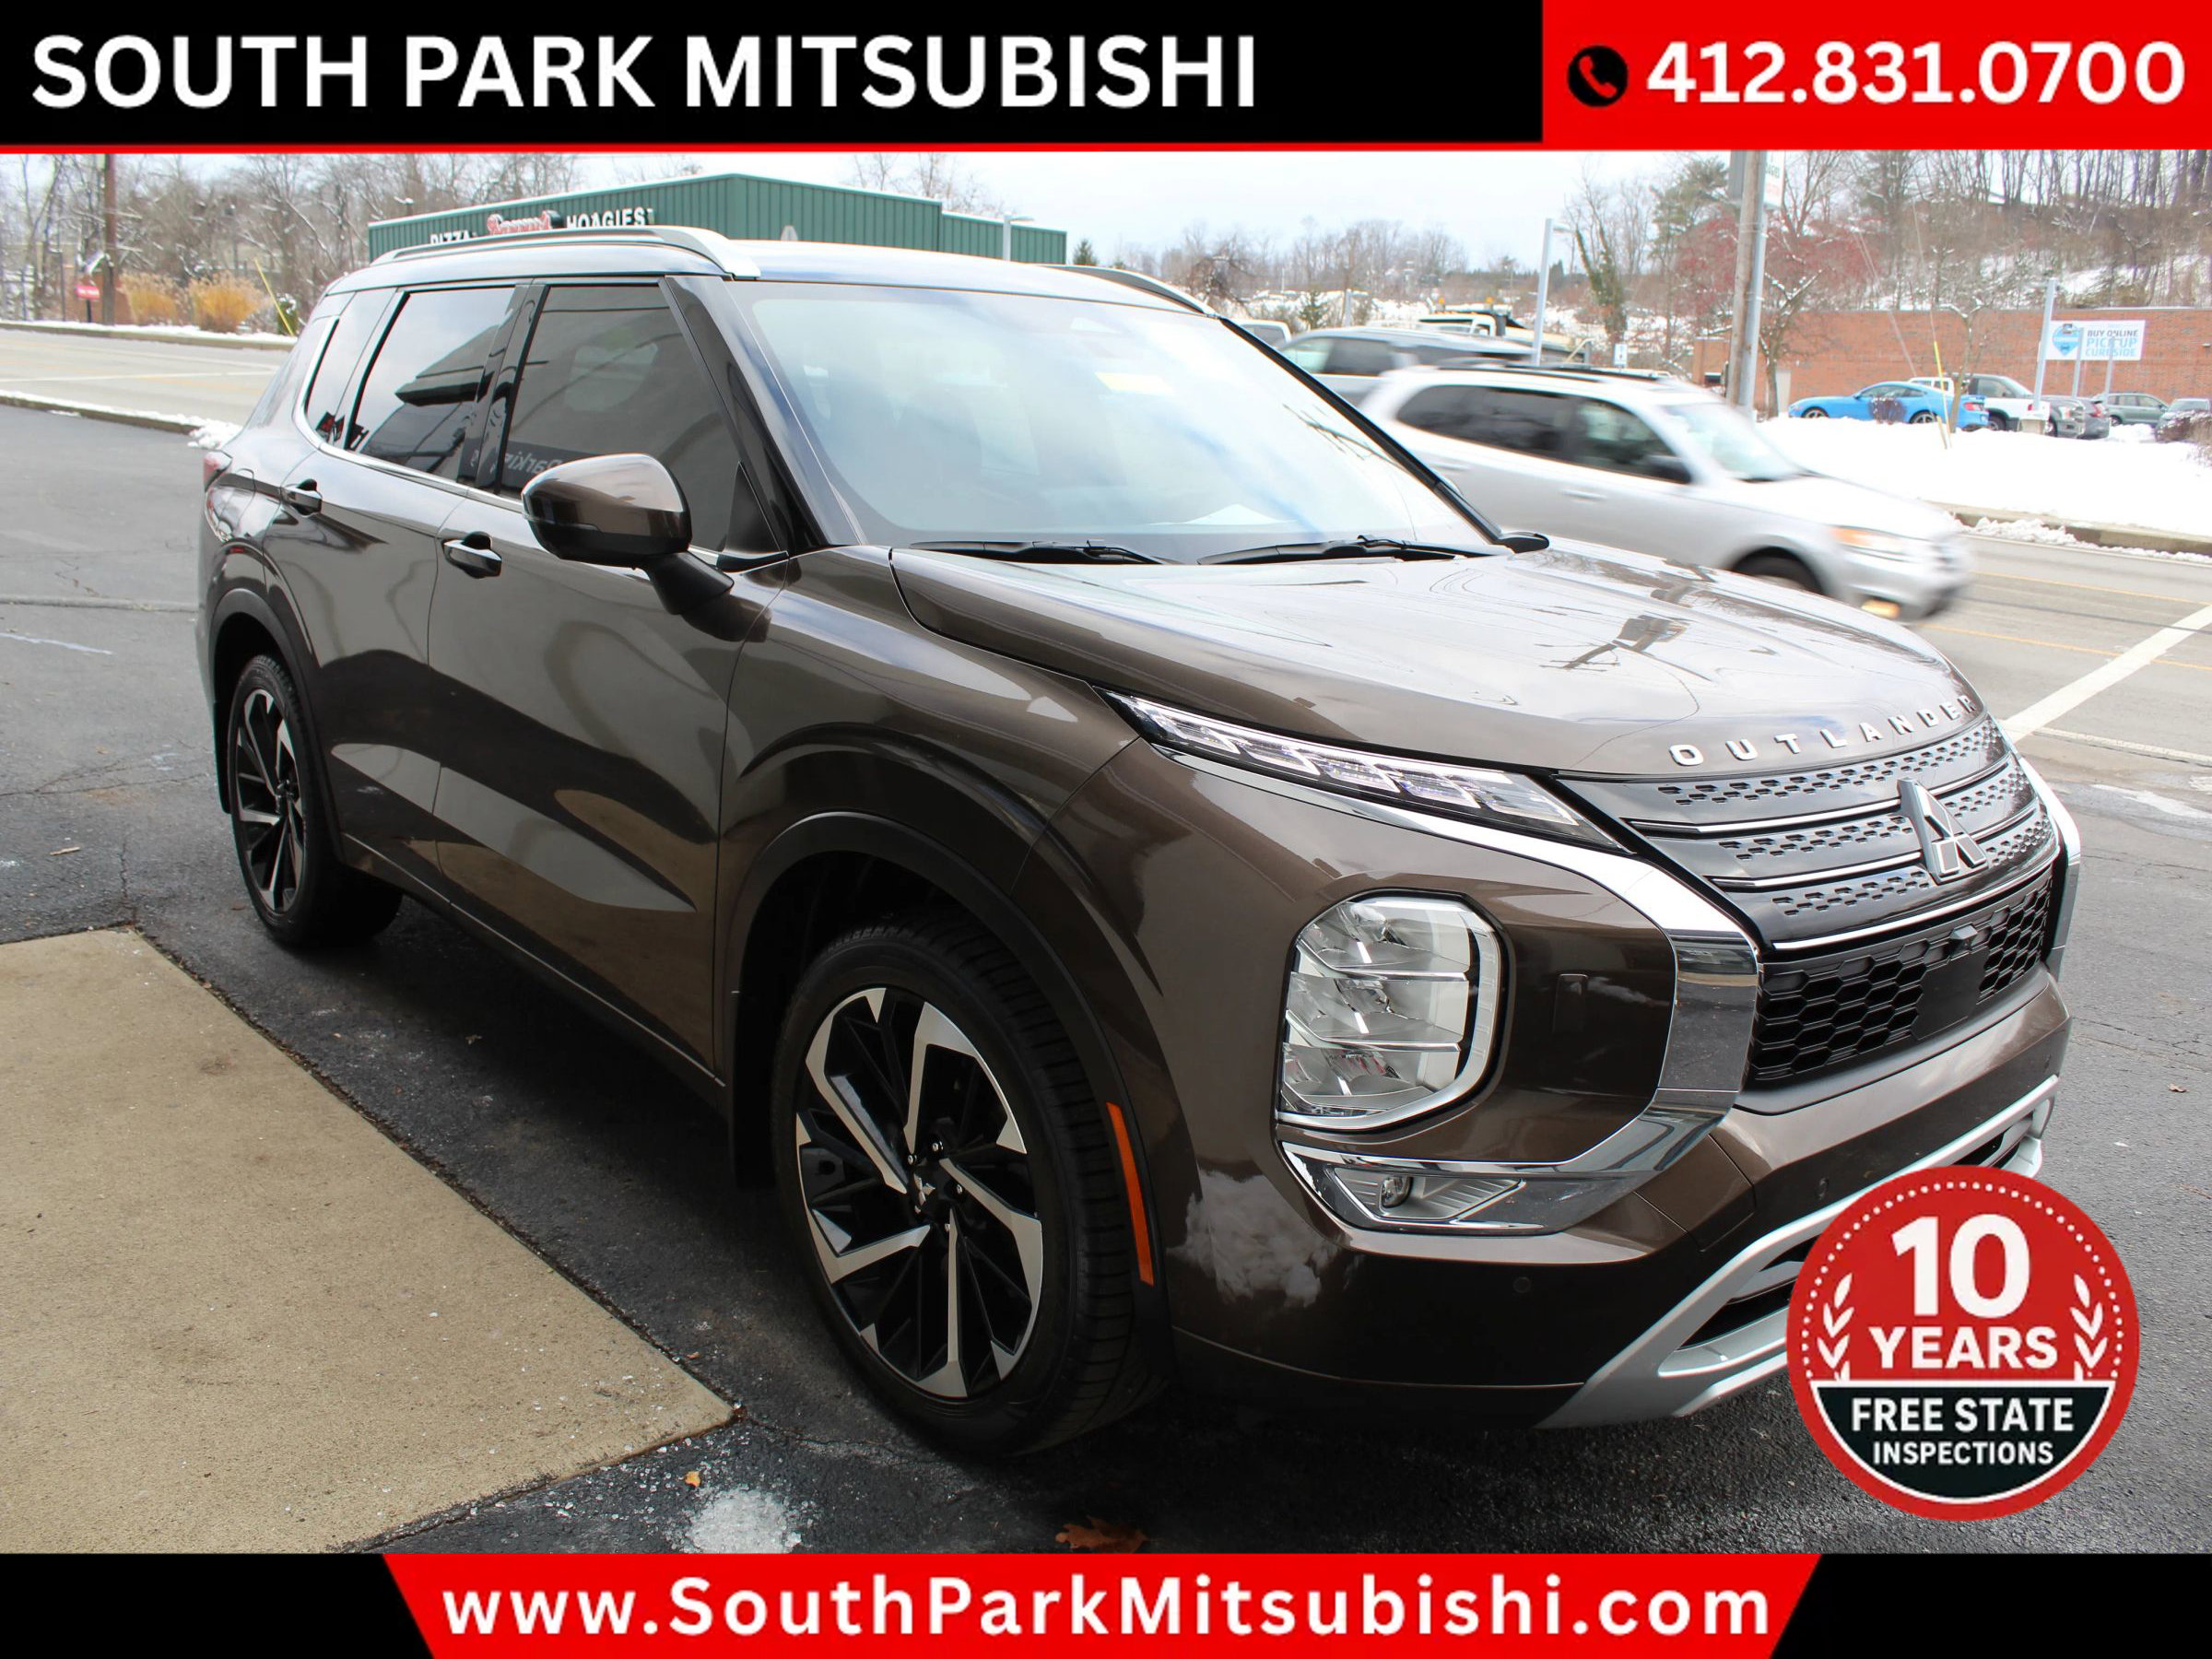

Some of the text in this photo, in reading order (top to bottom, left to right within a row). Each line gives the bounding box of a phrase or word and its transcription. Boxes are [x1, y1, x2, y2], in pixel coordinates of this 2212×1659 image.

[2088, 329, 2138, 337] BUY ONLINE
[1669, 695, 1977, 766] OUTLANDER
